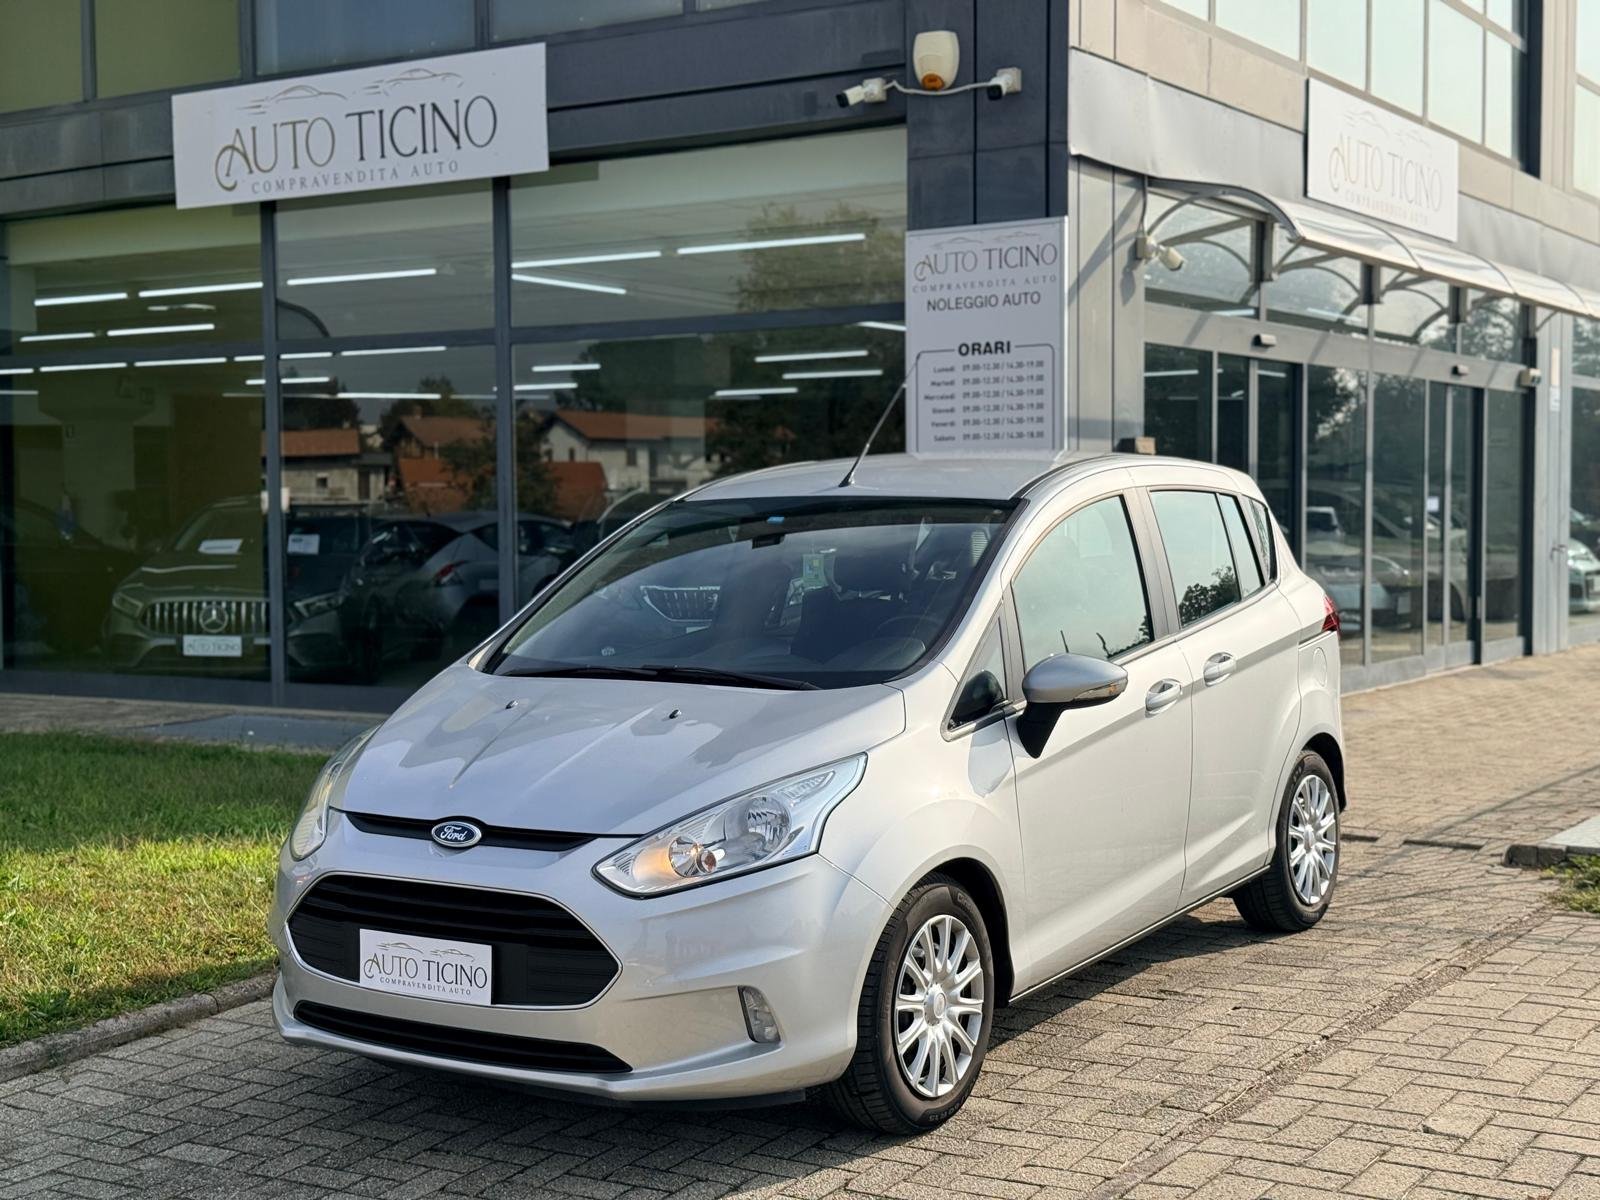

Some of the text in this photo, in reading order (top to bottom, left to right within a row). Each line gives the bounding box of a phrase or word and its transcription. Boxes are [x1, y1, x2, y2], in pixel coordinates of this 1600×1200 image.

[214, 95, 497, 192] AUTO TICINO
[1328, 132, 1384, 193] AUTO
[251, 159, 459, 195] COMPRAVENDITA AUTO
[913, 242, 1058, 282] AUTO TICINO
[912, 274, 1057, 293] COMPRAVENDITA AUTO
[926, 291, 1041, 312] NOLEGGIO AUTO
[958, 340, 1011, 356] ORARI
[440, 825, 468, 841] Ford
[363, 952, 488, 989] AUTO TICINO
[379, 976, 472, 996] COMPRAVENDITA AUTO
